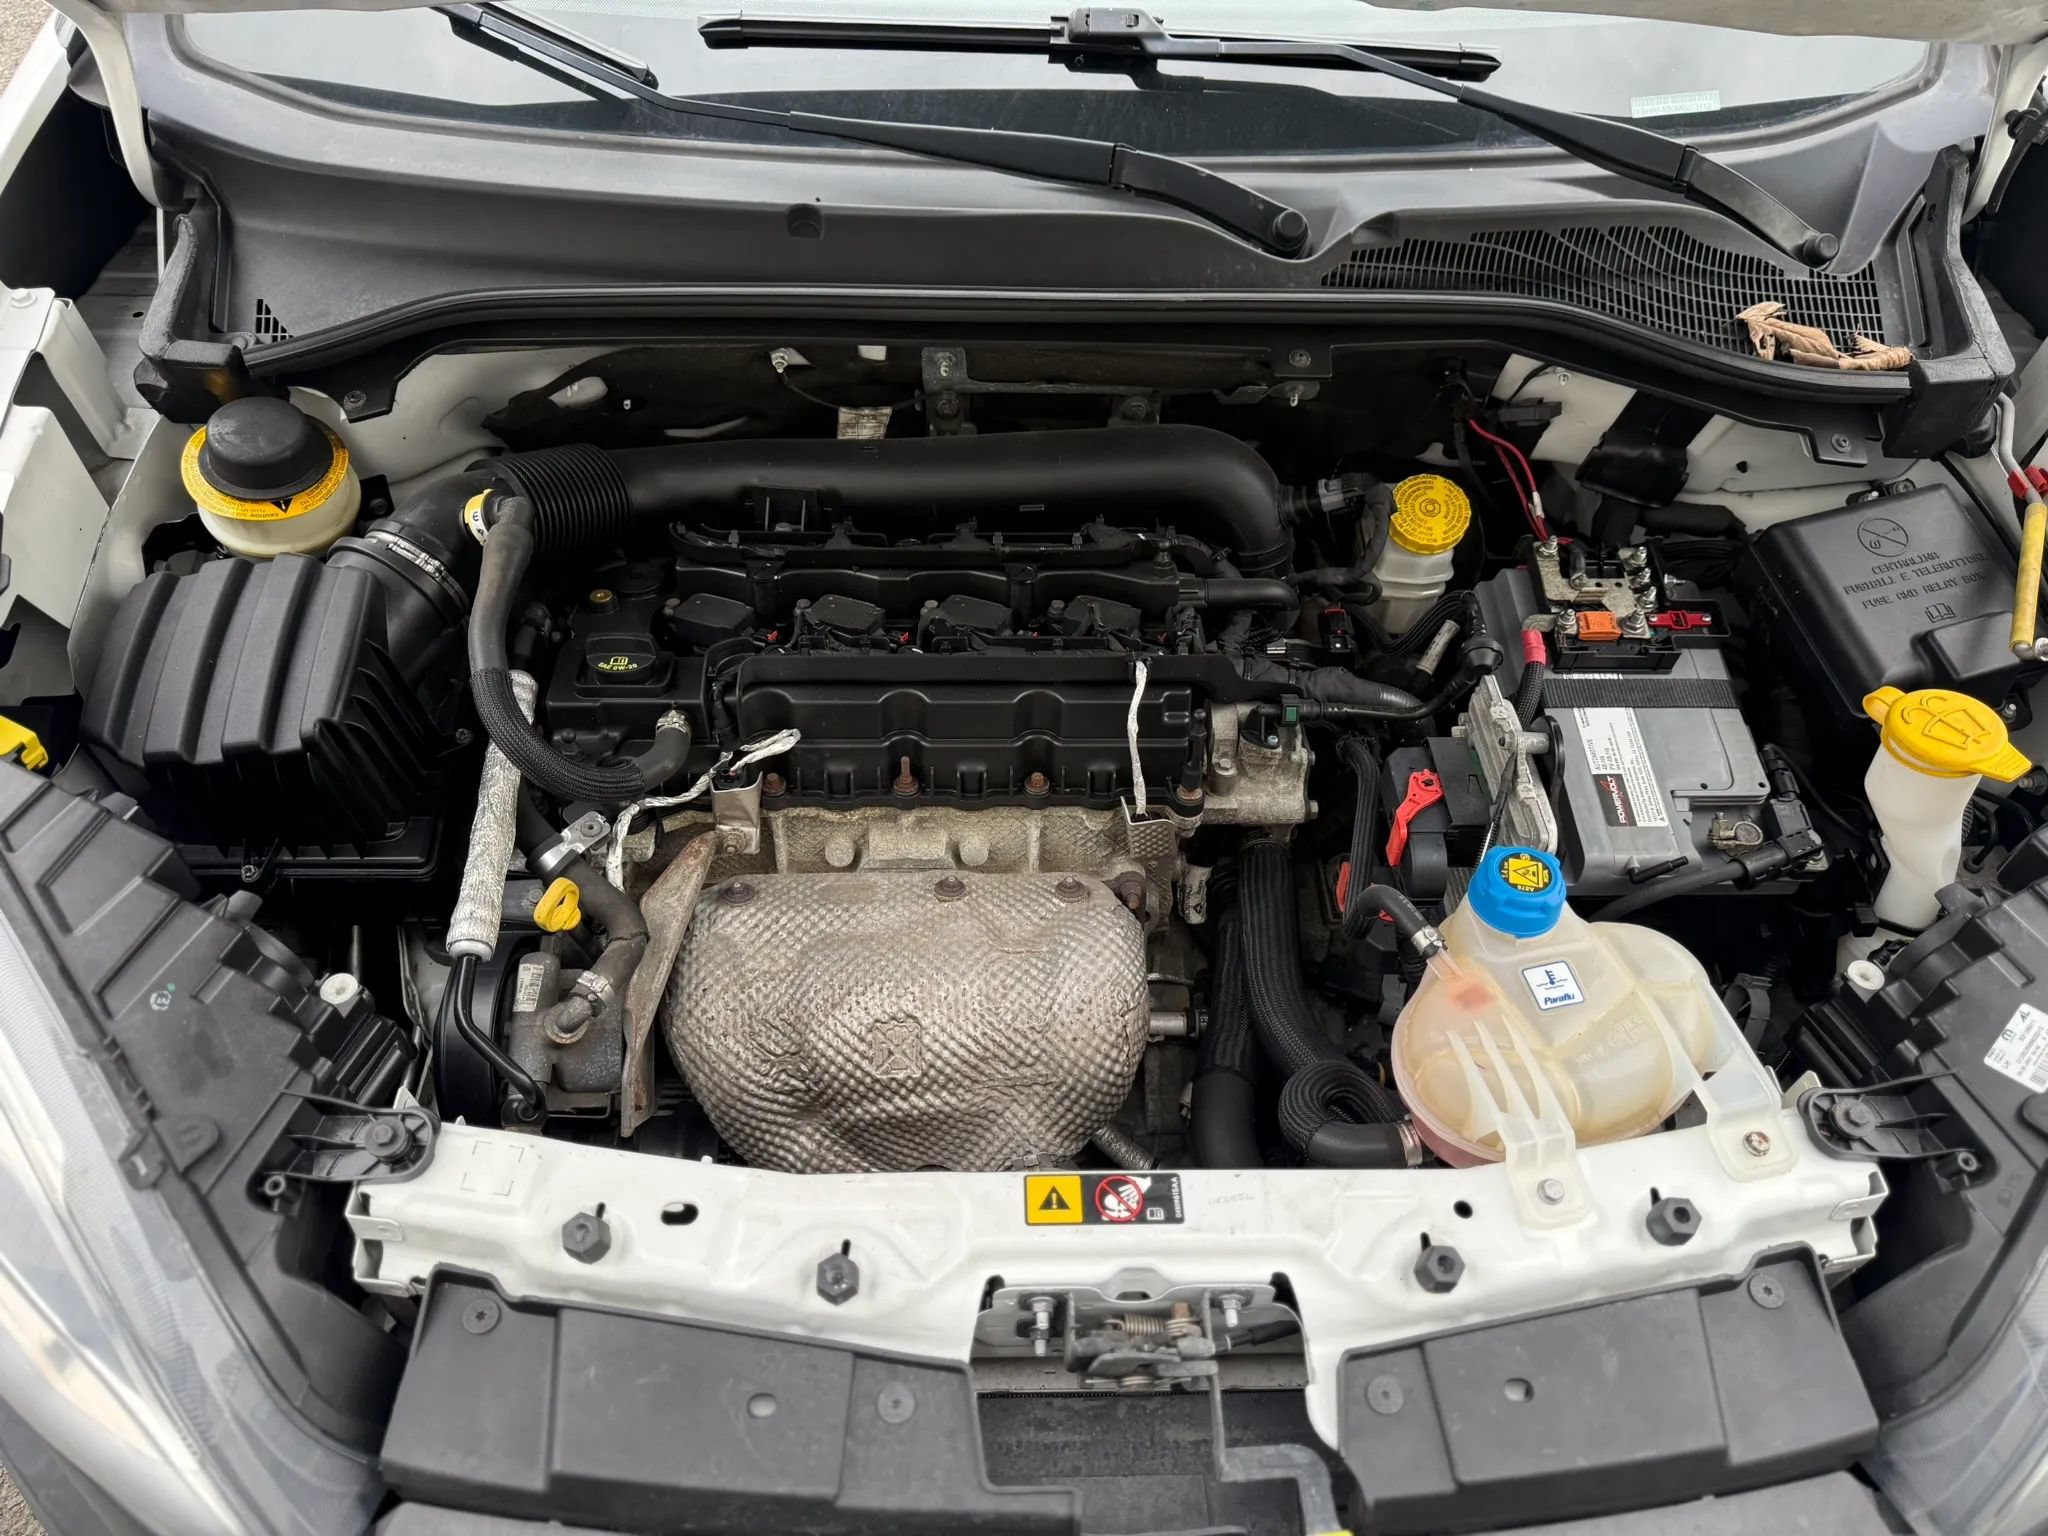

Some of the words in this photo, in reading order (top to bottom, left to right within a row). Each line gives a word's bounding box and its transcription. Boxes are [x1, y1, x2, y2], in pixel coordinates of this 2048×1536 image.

[1924, 580, 1958, 595] RELAY
[1606, 775, 1626, 823] POWERVOLT
[1544, 993, 1575, 1006] Paraflu
